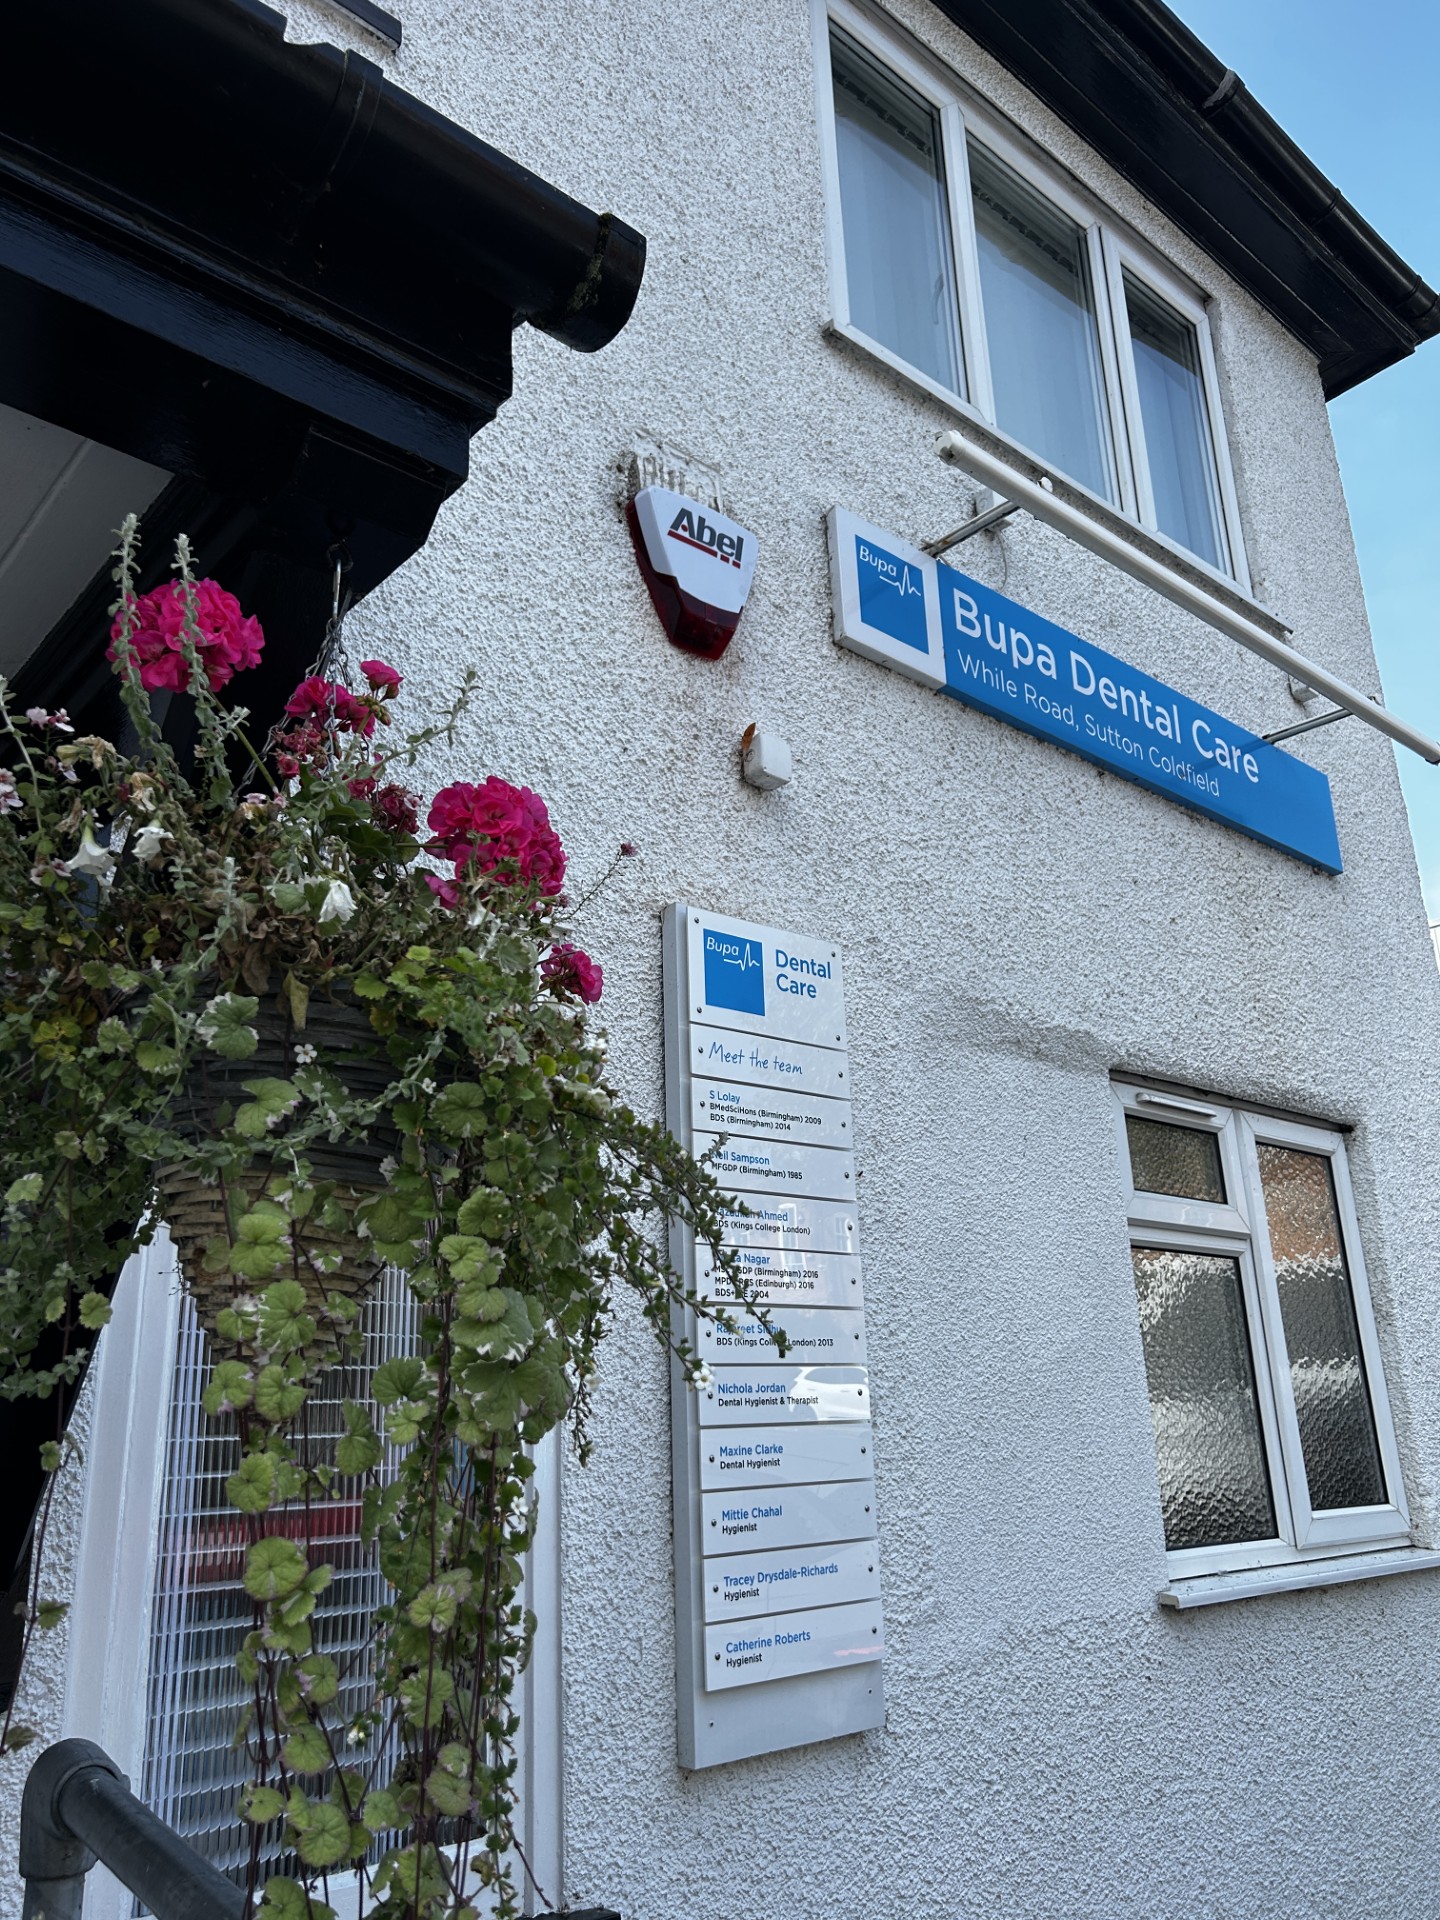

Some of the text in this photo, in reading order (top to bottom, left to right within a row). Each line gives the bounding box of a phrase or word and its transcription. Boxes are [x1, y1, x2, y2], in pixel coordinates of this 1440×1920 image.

[669, 507, 744, 562] Abel
[859, 545, 897, 577] Bupa
[953, 588, 1260, 783] Bupa Dental Care
[957, 648, 1220, 797] While Road, Sutton Coldfield
[706, 936, 739, 956] Bupa
[775, 949, 832, 979] Dental
[776, 973, 817, 998] Care
[708, 1042, 803, 1074] Meet the team
[709, 1090, 740, 1104] S Lolay
[710, 1103, 822, 1125] BMedSciHons (Birmingham) 2009
[710, 1113, 791, 1130] BDS (Birmingham) 2014
[731, 1152, 770, 1165] Sampson
[712, 1163, 803, 1180] MFGDP (Birmingham) 1985
[758, 1210, 788, 1222] Ahmed
[714, 1220, 810, 1235] BDS (Kings College London)
[744, 1253, 770, 1265] Nagar
[754, 1268, 801, 1279] (Birmingham)
[803, 1270, 819, 1279] 2016
[755, 1280, 797, 1290] (Edinburgh)
[798, 1281, 815, 1290] 2016
[716, 1324, 755, 1335] Rareet
[716, 1338, 834, 1347] BDS (Kings Coll London) 2013
[718, 1383, 786, 1394] Nichola Jordan
[718, 1398, 742, 1406] Dental
[745, 1397, 778, 1407] Hygienist
[787, 1396, 818, 1405] Therapist
[720, 1444, 783, 1456] Maxine Clarke
[720, 1458, 780, 1469] Dental Hygienist
[722, 1506, 782, 1521] Mittie Chahal
[722, 1523, 757, 1535] Hygienist
[724, 1563, 838, 1587] Tracey Drysdale-Richards
[724, 1588, 759, 1601] Hygienist
[726, 1630, 811, 1653] Catherine Roberts
[726, 1653, 762, 1668] Hygienist
